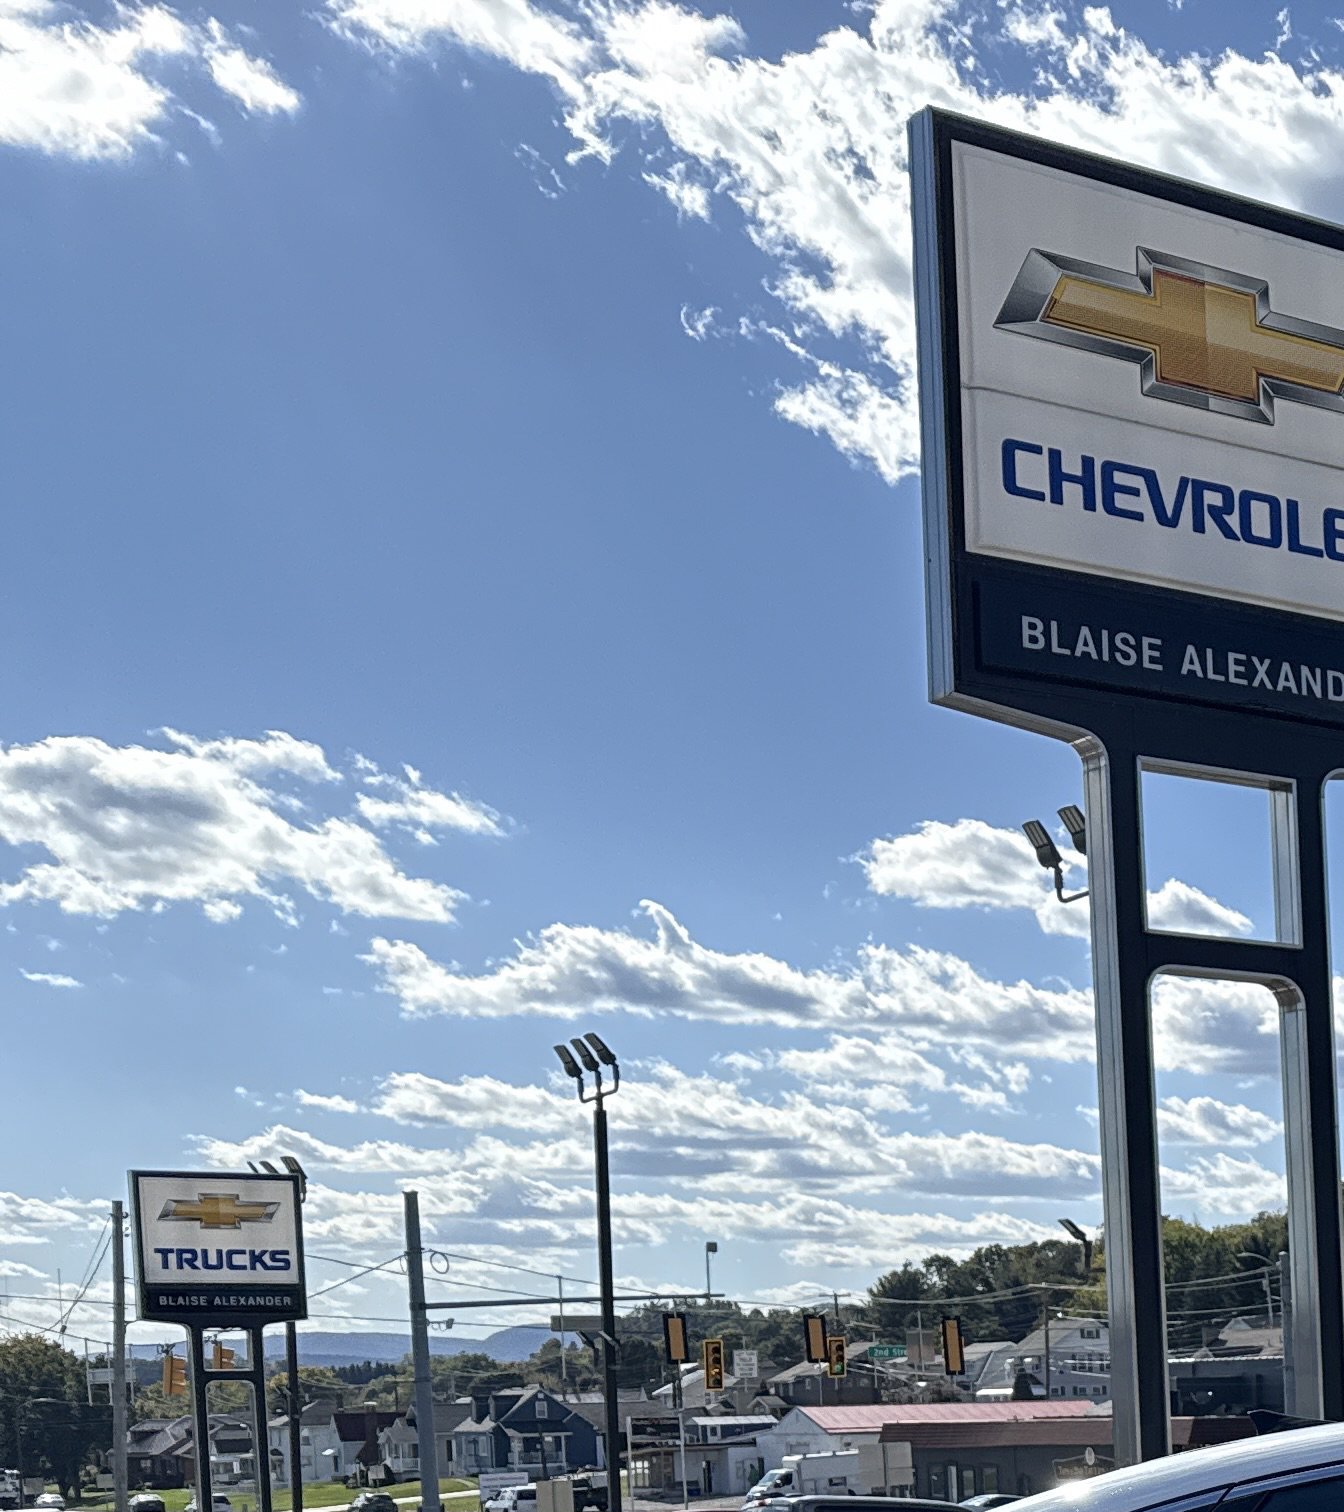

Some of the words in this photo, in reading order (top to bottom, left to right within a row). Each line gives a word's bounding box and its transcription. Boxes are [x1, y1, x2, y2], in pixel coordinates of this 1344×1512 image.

[1021, 615, 1164, 671] BLAISE
[153, 1247, 291, 1271] TRUCKS
[159, 1295, 207, 1306] BLAISE
[213, 1295, 292, 1306] ALEXANDER
[873, 1347, 889, 1357] 2nd
[892, 1347, 908, 1357] Stre
